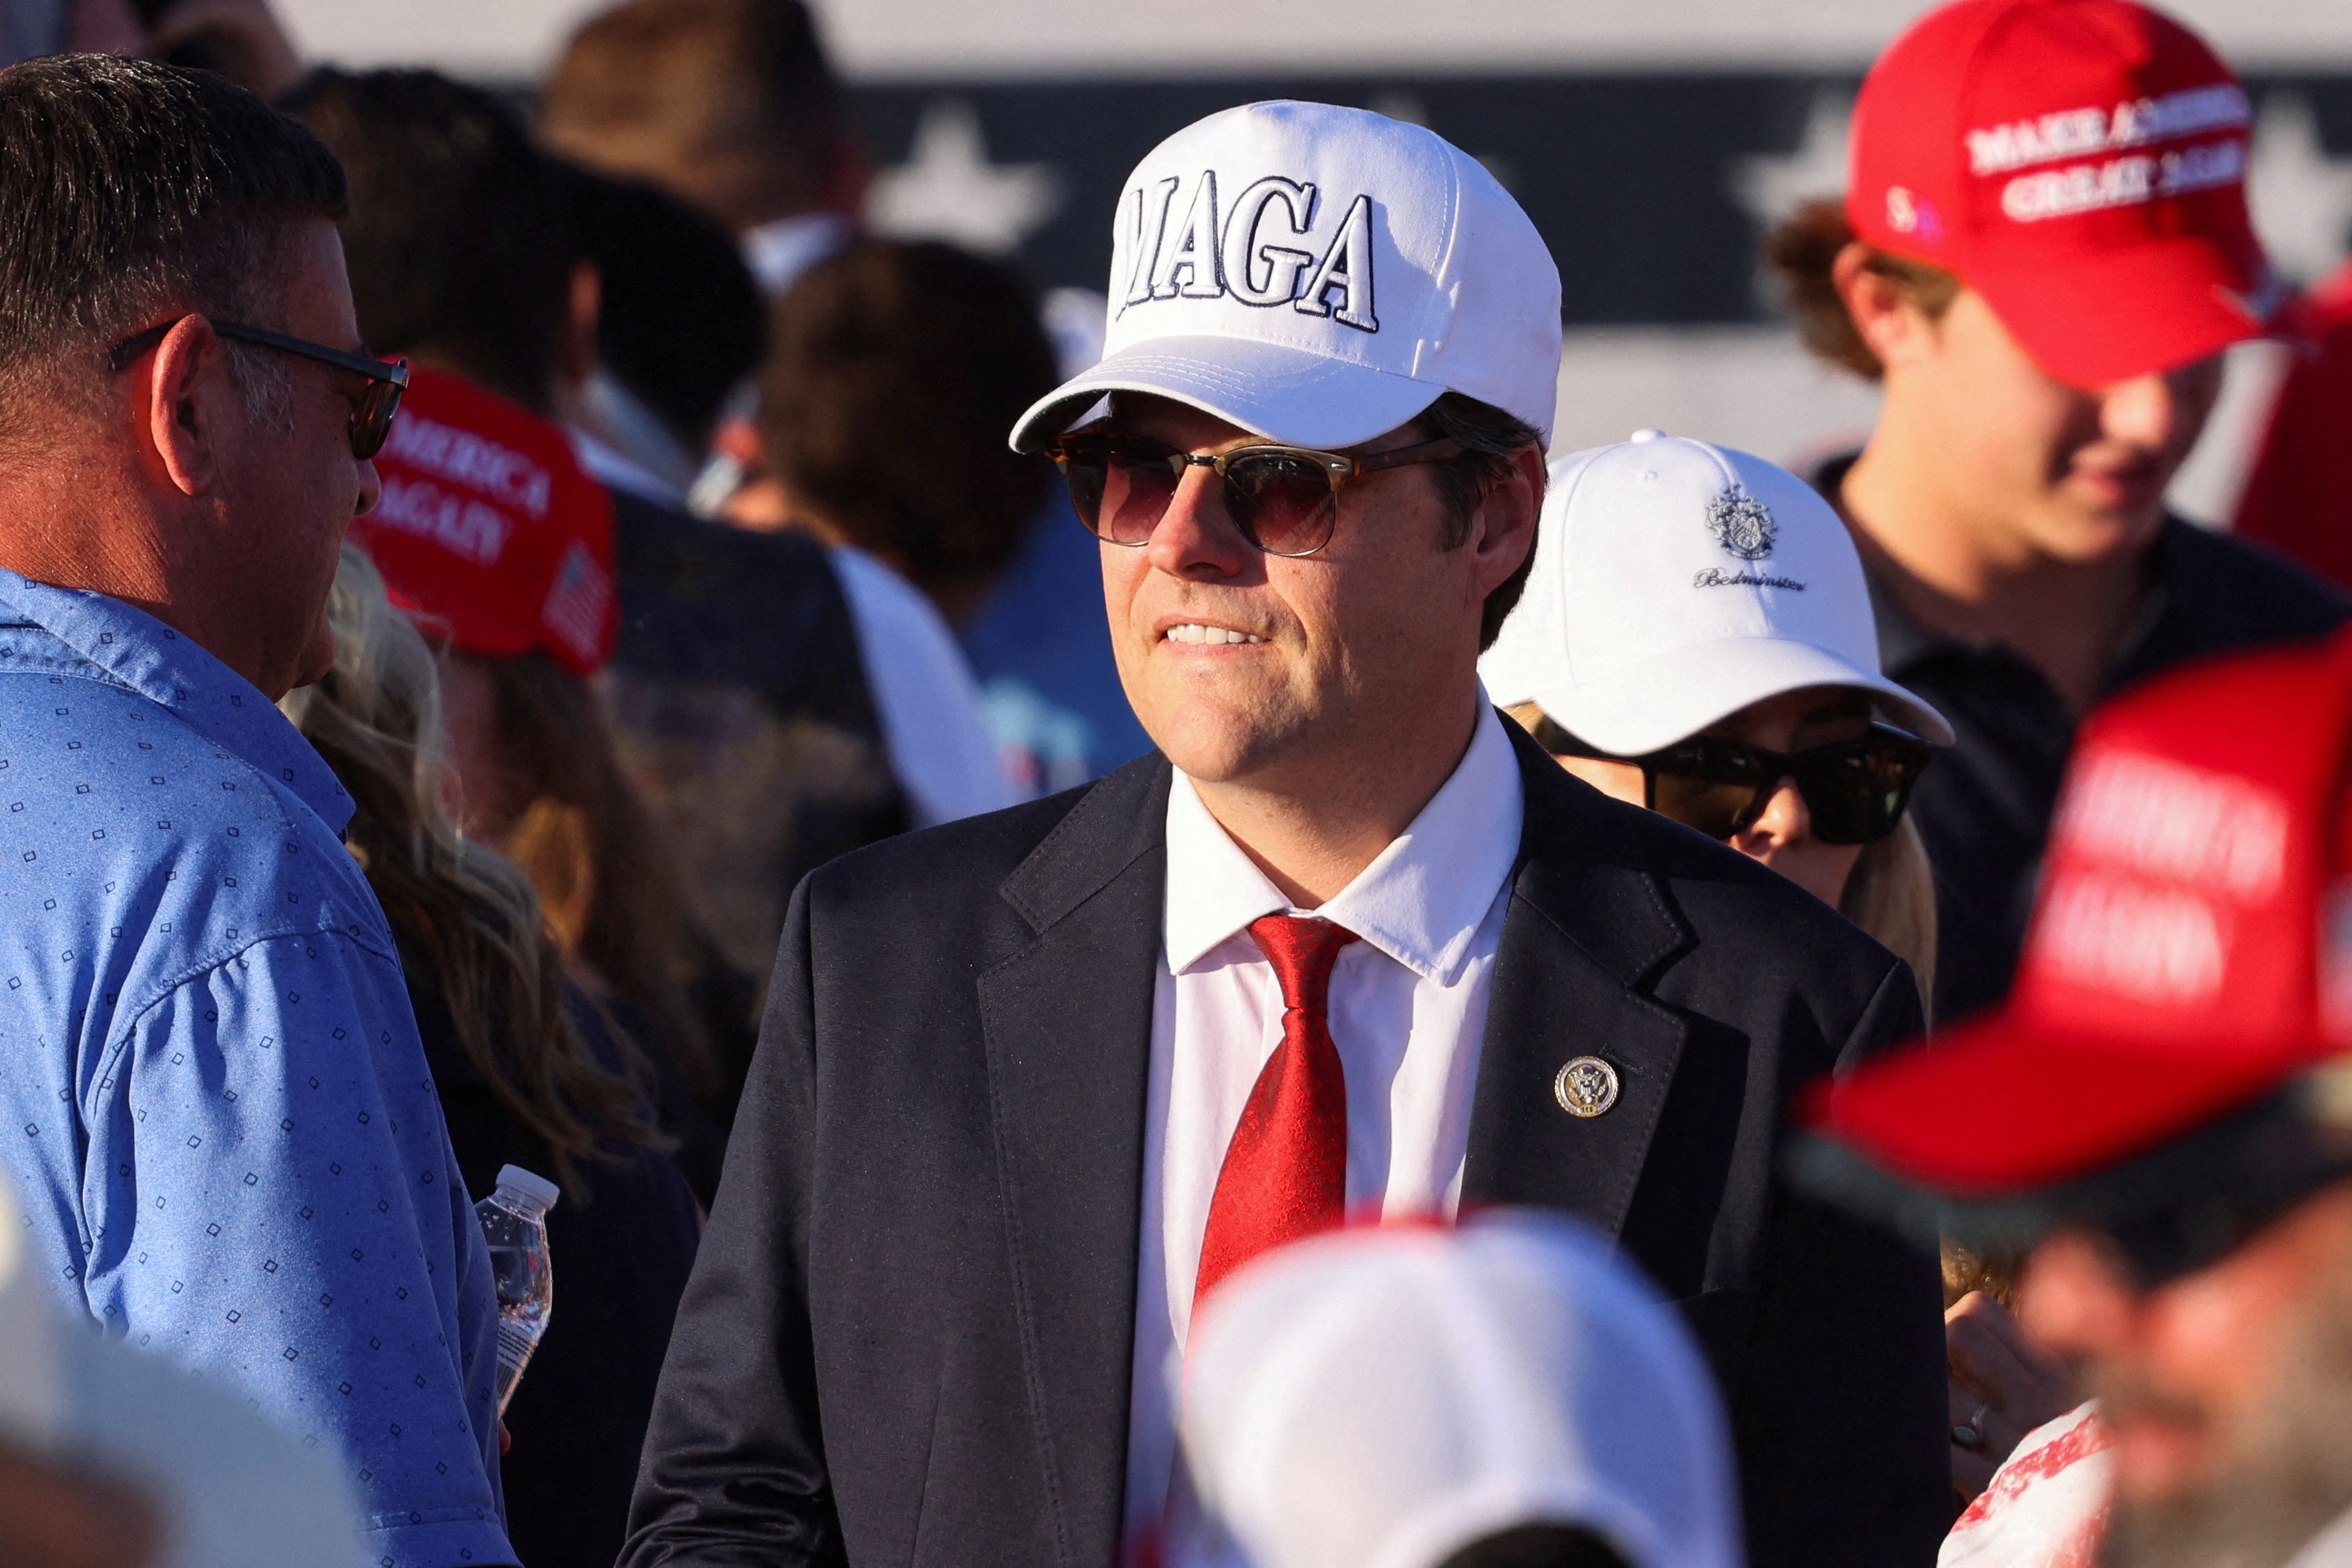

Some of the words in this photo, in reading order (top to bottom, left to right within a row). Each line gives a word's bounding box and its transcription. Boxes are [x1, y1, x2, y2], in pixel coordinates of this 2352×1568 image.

[1965, 106, 2106, 176] MAKE
[2110, 83, 2249, 150] AMERIC
[2001, 156, 2156, 223] GREAT
[1694, 567, 1807, 592] Bedminster
